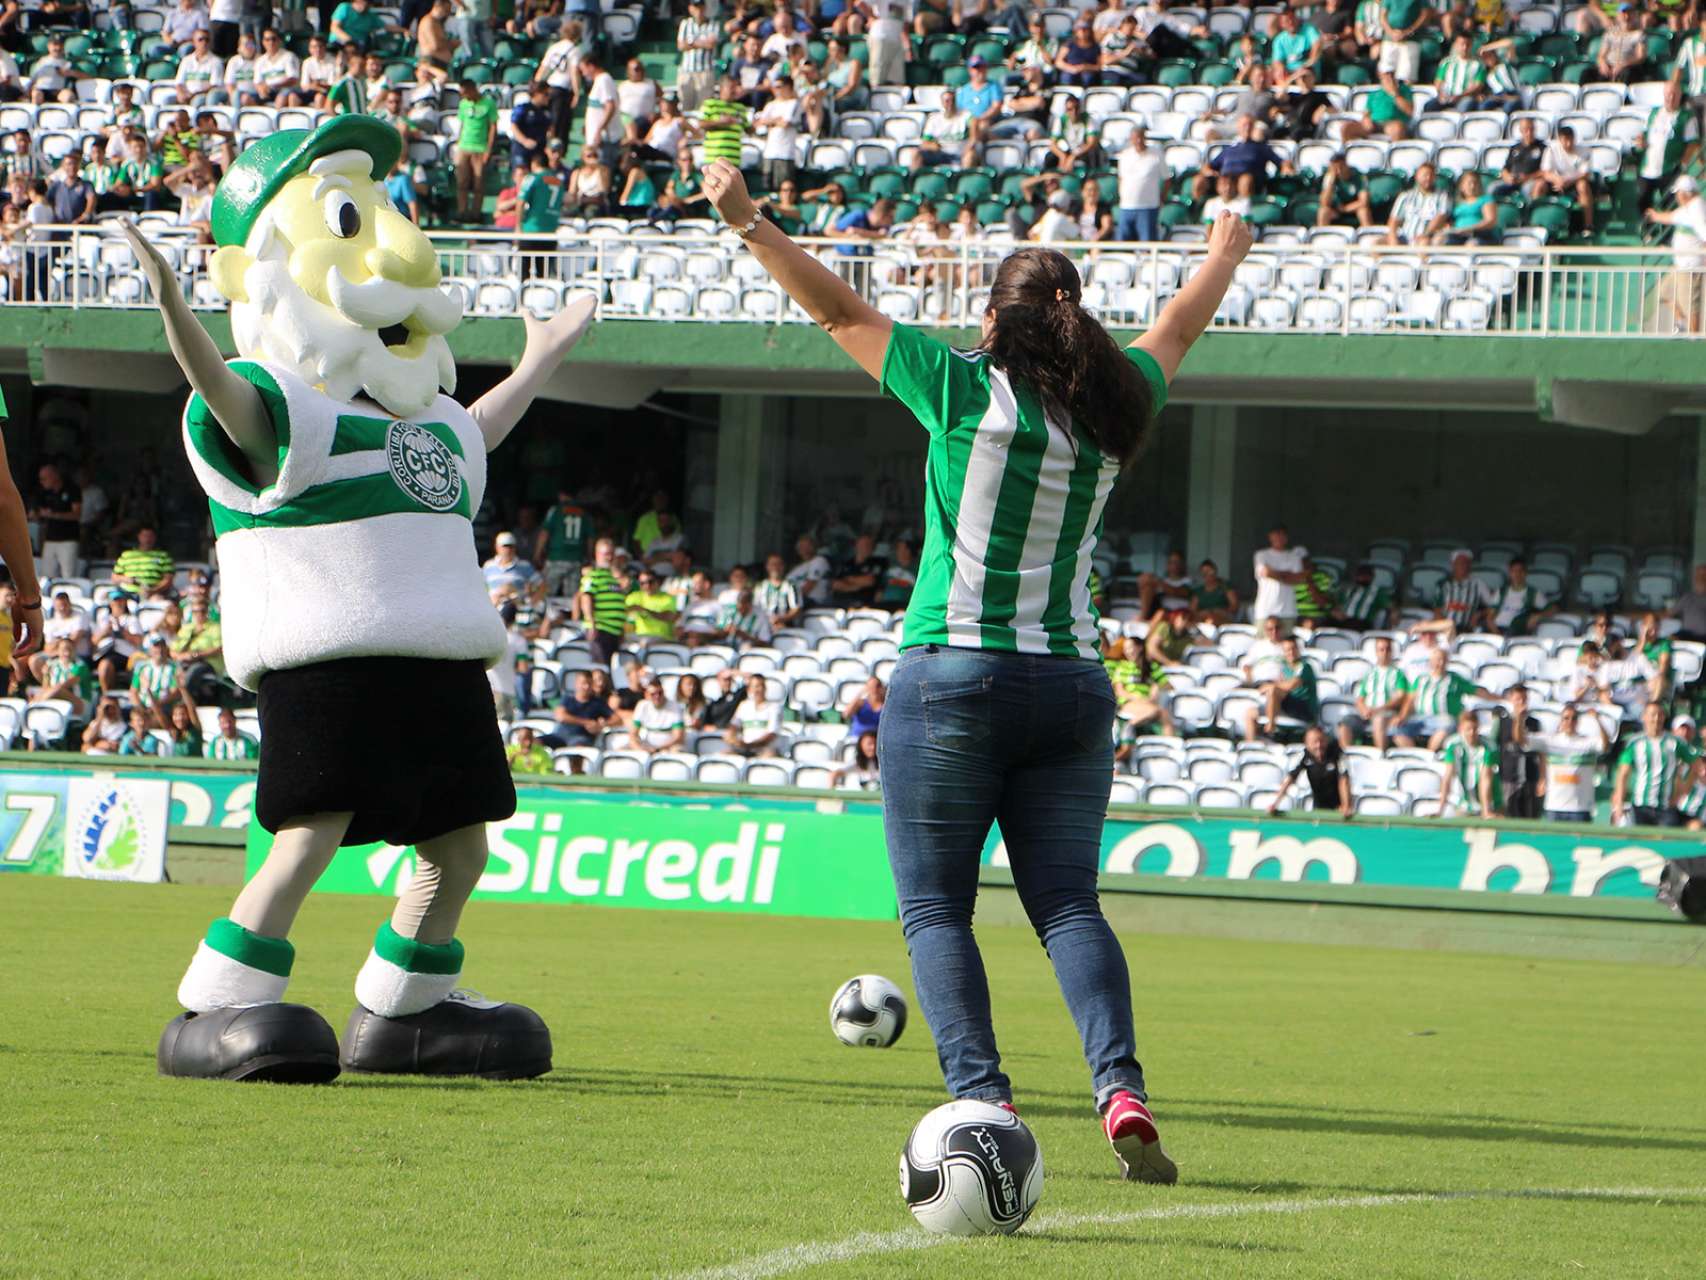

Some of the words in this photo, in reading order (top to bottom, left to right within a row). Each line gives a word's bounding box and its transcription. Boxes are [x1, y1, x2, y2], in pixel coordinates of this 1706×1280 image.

[405, 449, 446, 475] CFC
[563, 515, 582, 540] 11
[5, 794, 57, 863] 7
[477, 812, 785, 904] Sicredi
[970, 1127, 1015, 1214] PENALTY
